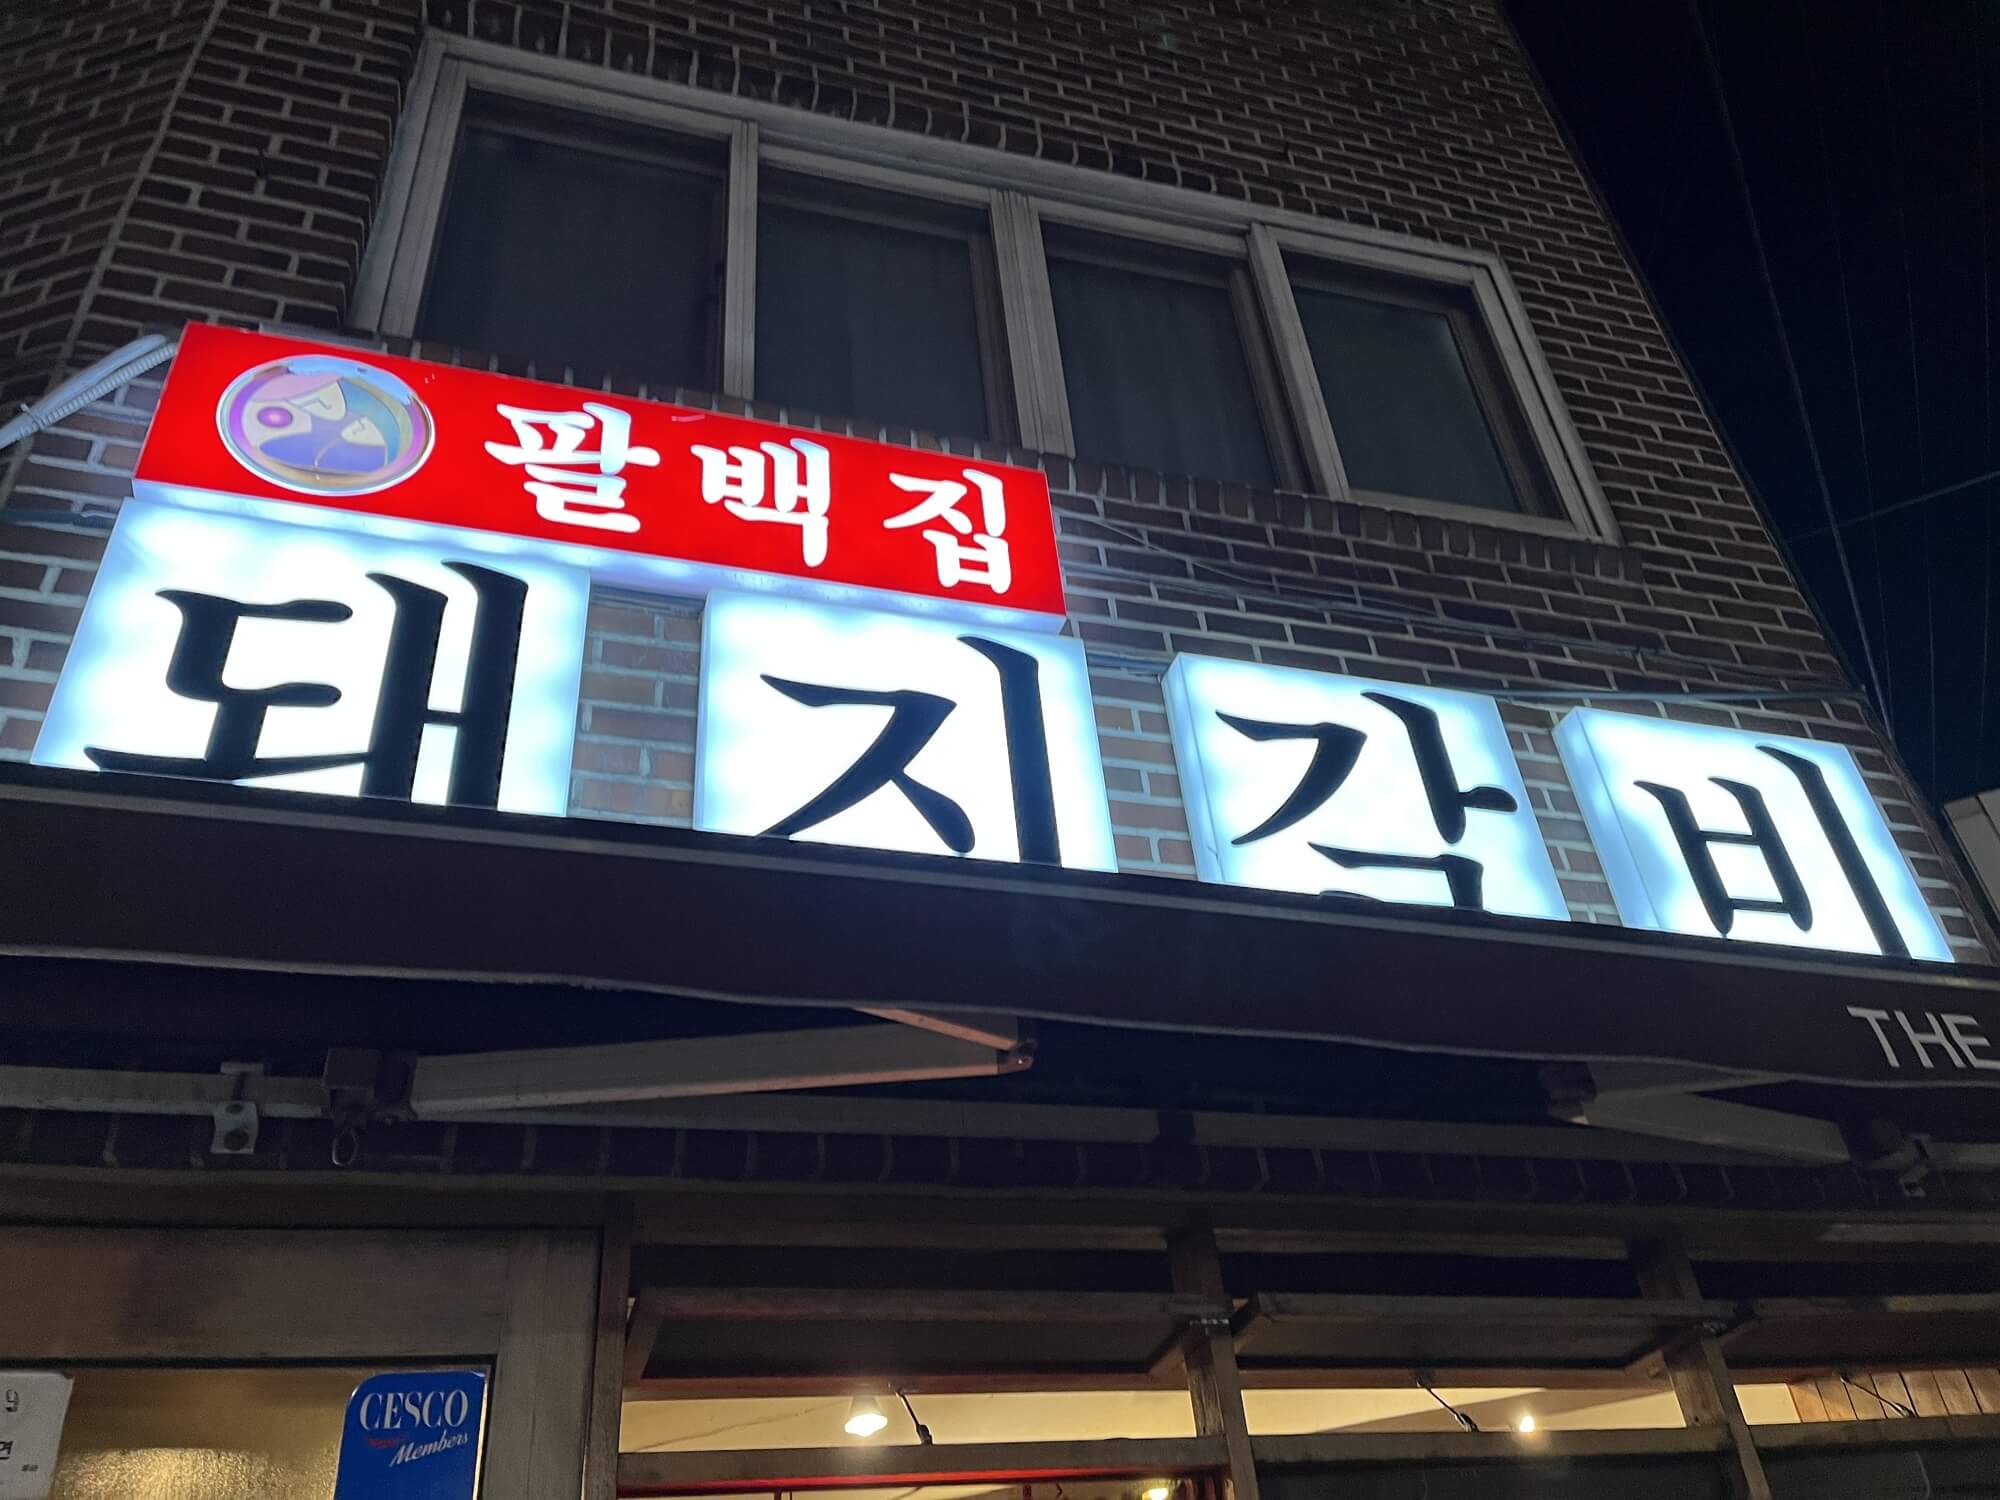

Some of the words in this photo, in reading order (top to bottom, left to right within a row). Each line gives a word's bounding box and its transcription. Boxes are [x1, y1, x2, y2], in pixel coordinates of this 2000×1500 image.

[1846, 1005, 2000, 1070] THE
[359, 1389, 469, 1431] CESCO
[388, 1429, 468, 1467] Members
